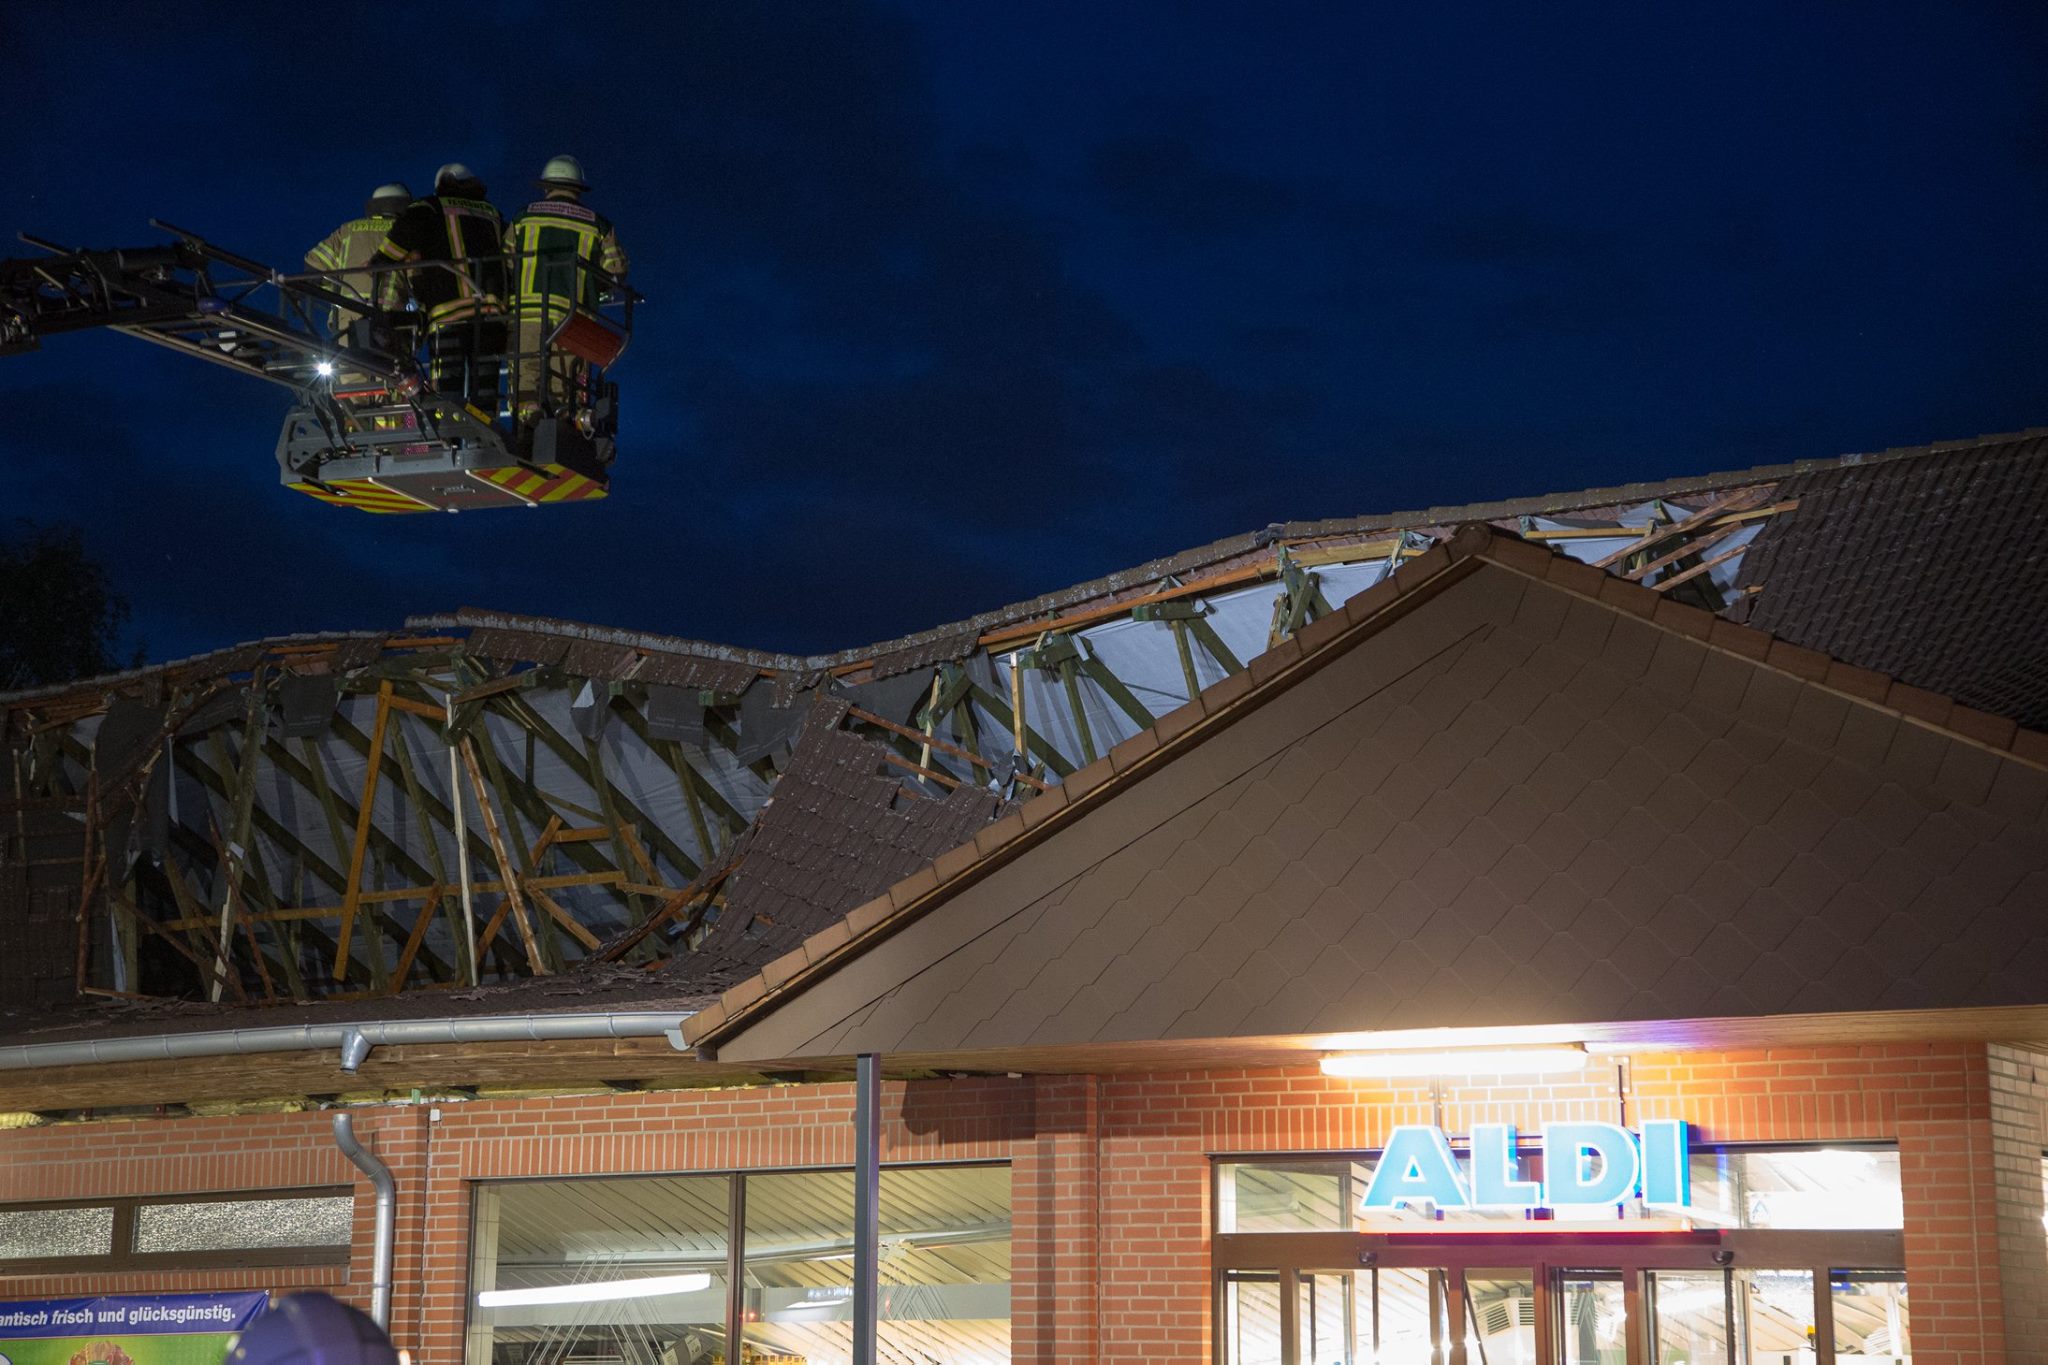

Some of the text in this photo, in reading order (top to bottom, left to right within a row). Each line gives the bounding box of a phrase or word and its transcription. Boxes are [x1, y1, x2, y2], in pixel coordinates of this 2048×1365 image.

[1360, 1119, 1691, 1211] ALDI
[51, 1309, 93, 1325] frisch
[98, 1307, 126, 1323] und
[129, 1304, 236, 1325] glücksgünstig.
